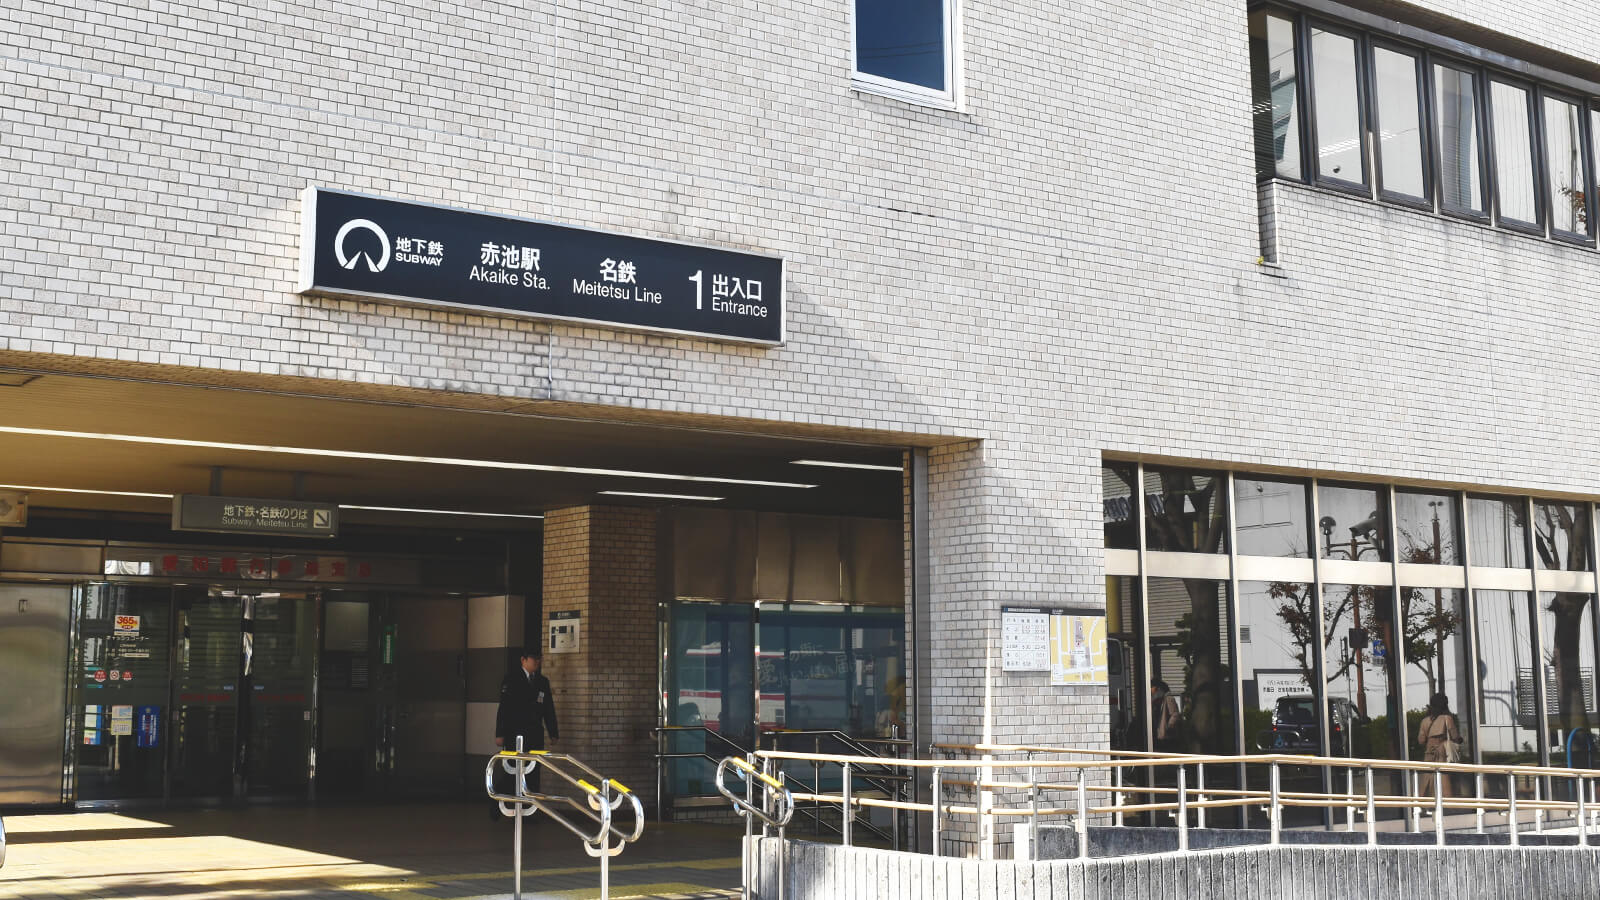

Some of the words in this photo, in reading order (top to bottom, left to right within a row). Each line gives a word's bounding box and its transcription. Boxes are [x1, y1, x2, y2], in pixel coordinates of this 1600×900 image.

[396, 236, 444, 256] 地下鉄
[480, 241, 540, 271] 赤池駅
[395, 252, 443, 267] SUBWAY
[599, 257, 637, 284] 名鉄
[469, 265, 519, 286] Akaike
[523, 271, 551, 290] Sta.
[688, 269, 703, 310] 1
[712, 273, 762, 302] 出入口
[573, 278, 630, 301] Meitetsu
[635, 286, 662, 304] Line
[712, 297, 768, 318] Entrance
